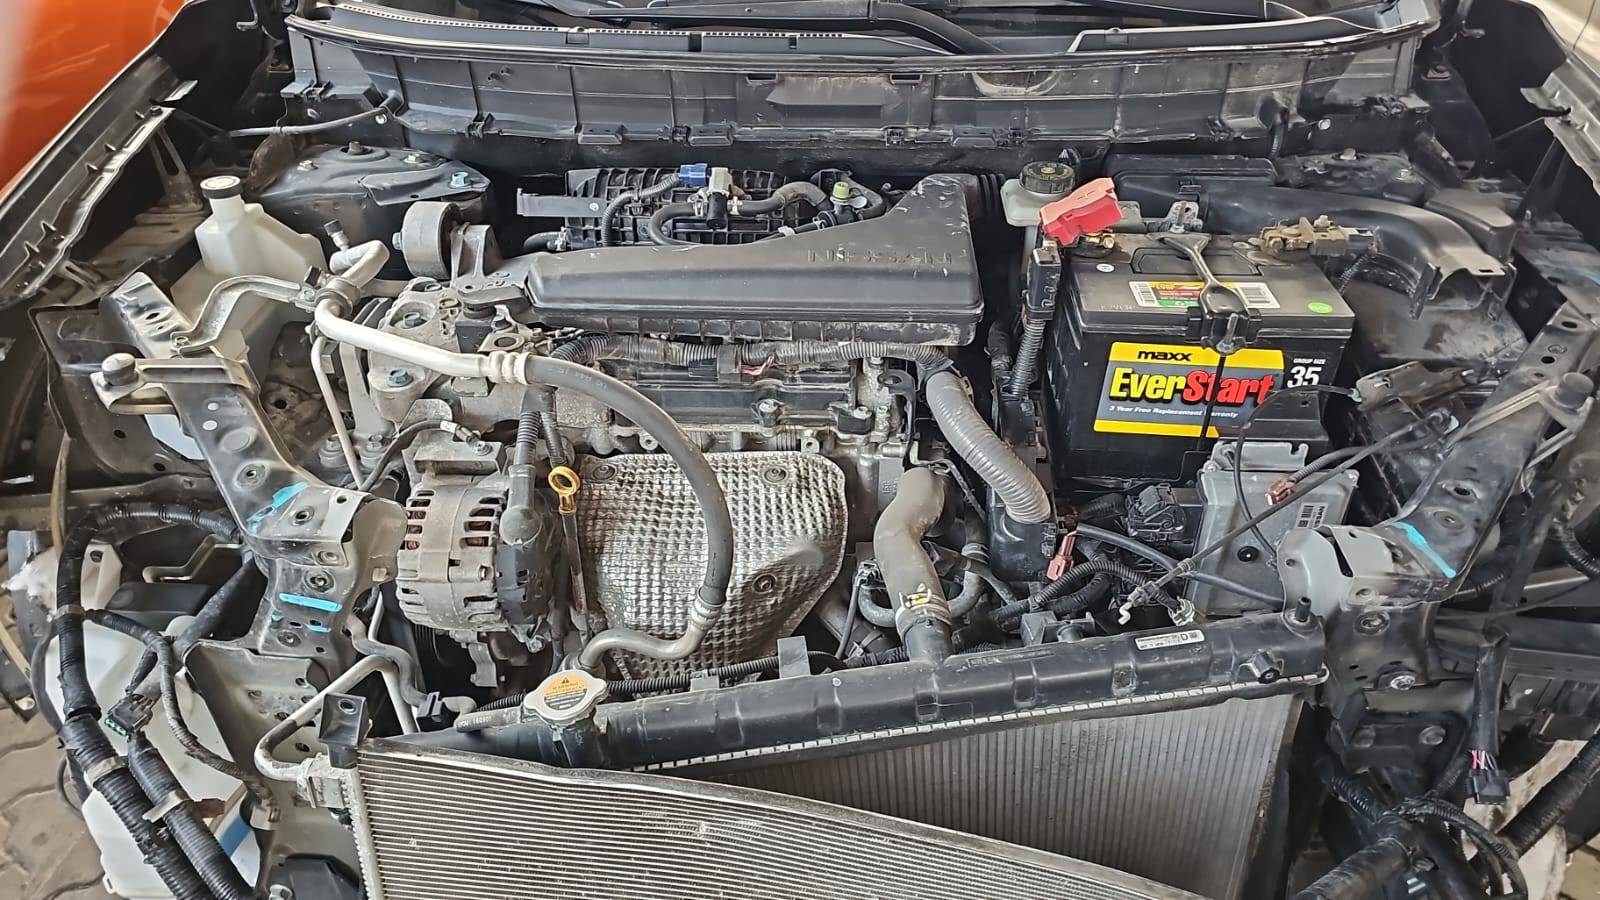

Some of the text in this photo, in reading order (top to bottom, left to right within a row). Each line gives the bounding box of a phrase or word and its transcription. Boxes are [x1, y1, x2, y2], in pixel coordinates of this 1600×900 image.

[1137, 349, 1192, 362] maxx
[1287, 365, 1322, 388] 35
[1152, 407, 1204, 416] Replacement
[1181, 633, 1189, 641] D
